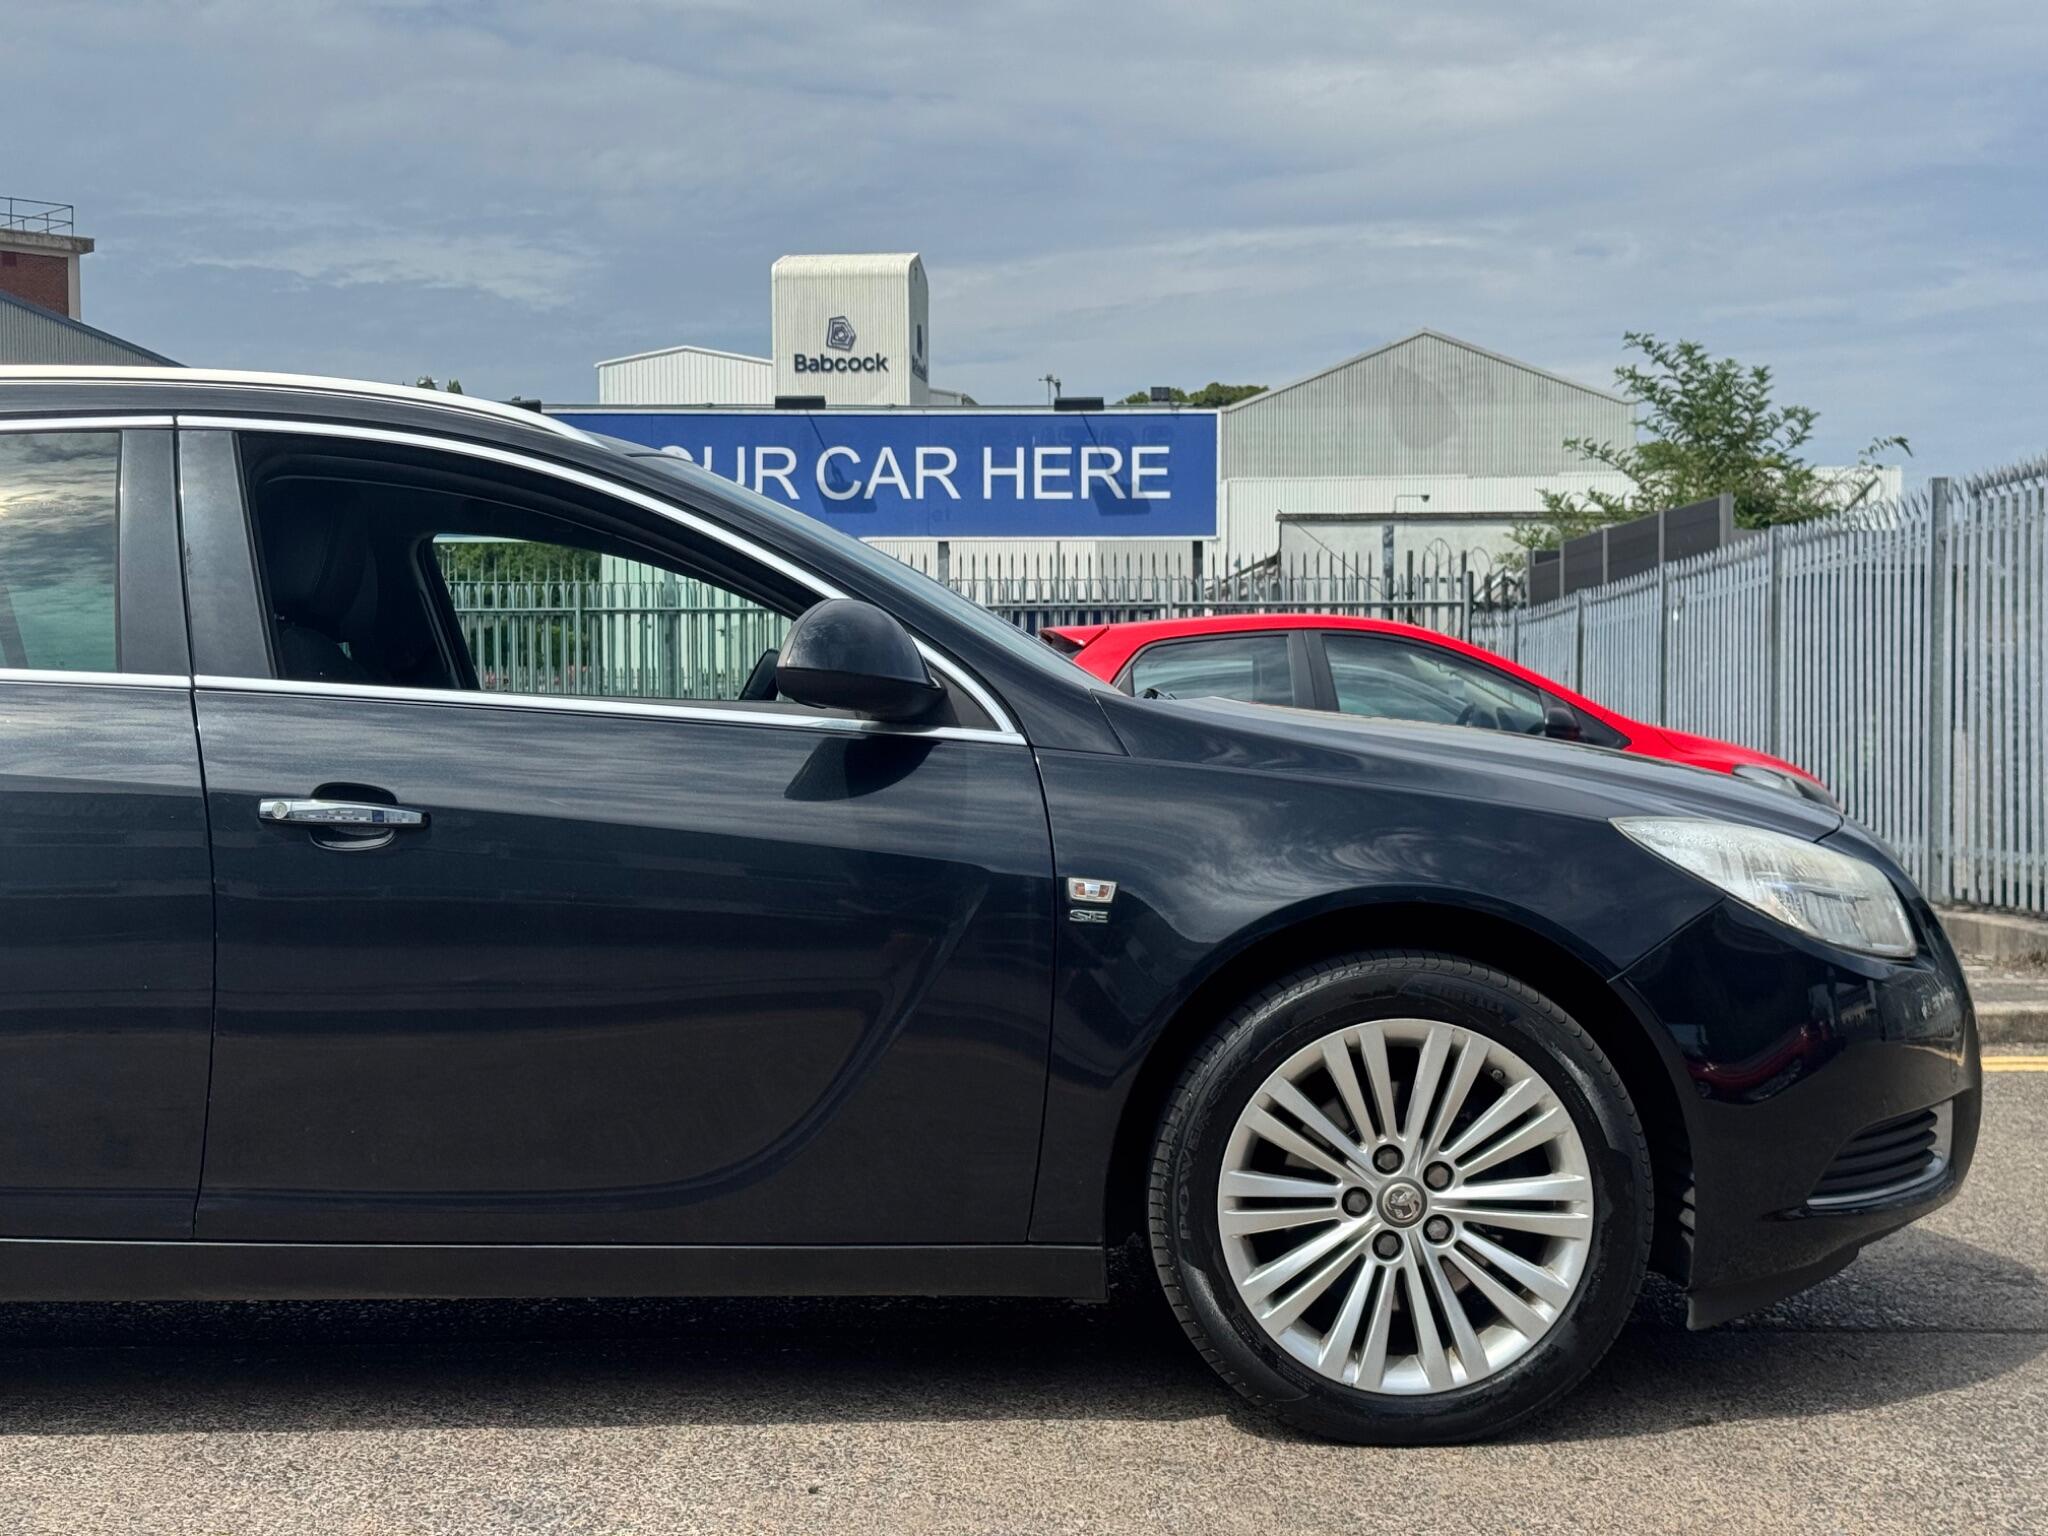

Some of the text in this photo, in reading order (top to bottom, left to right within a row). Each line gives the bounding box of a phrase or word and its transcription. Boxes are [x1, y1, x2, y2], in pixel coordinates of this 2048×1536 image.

[794, 353, 889, 373] Babcock
[661, 445, 1172, 501] UR CAR HERE
